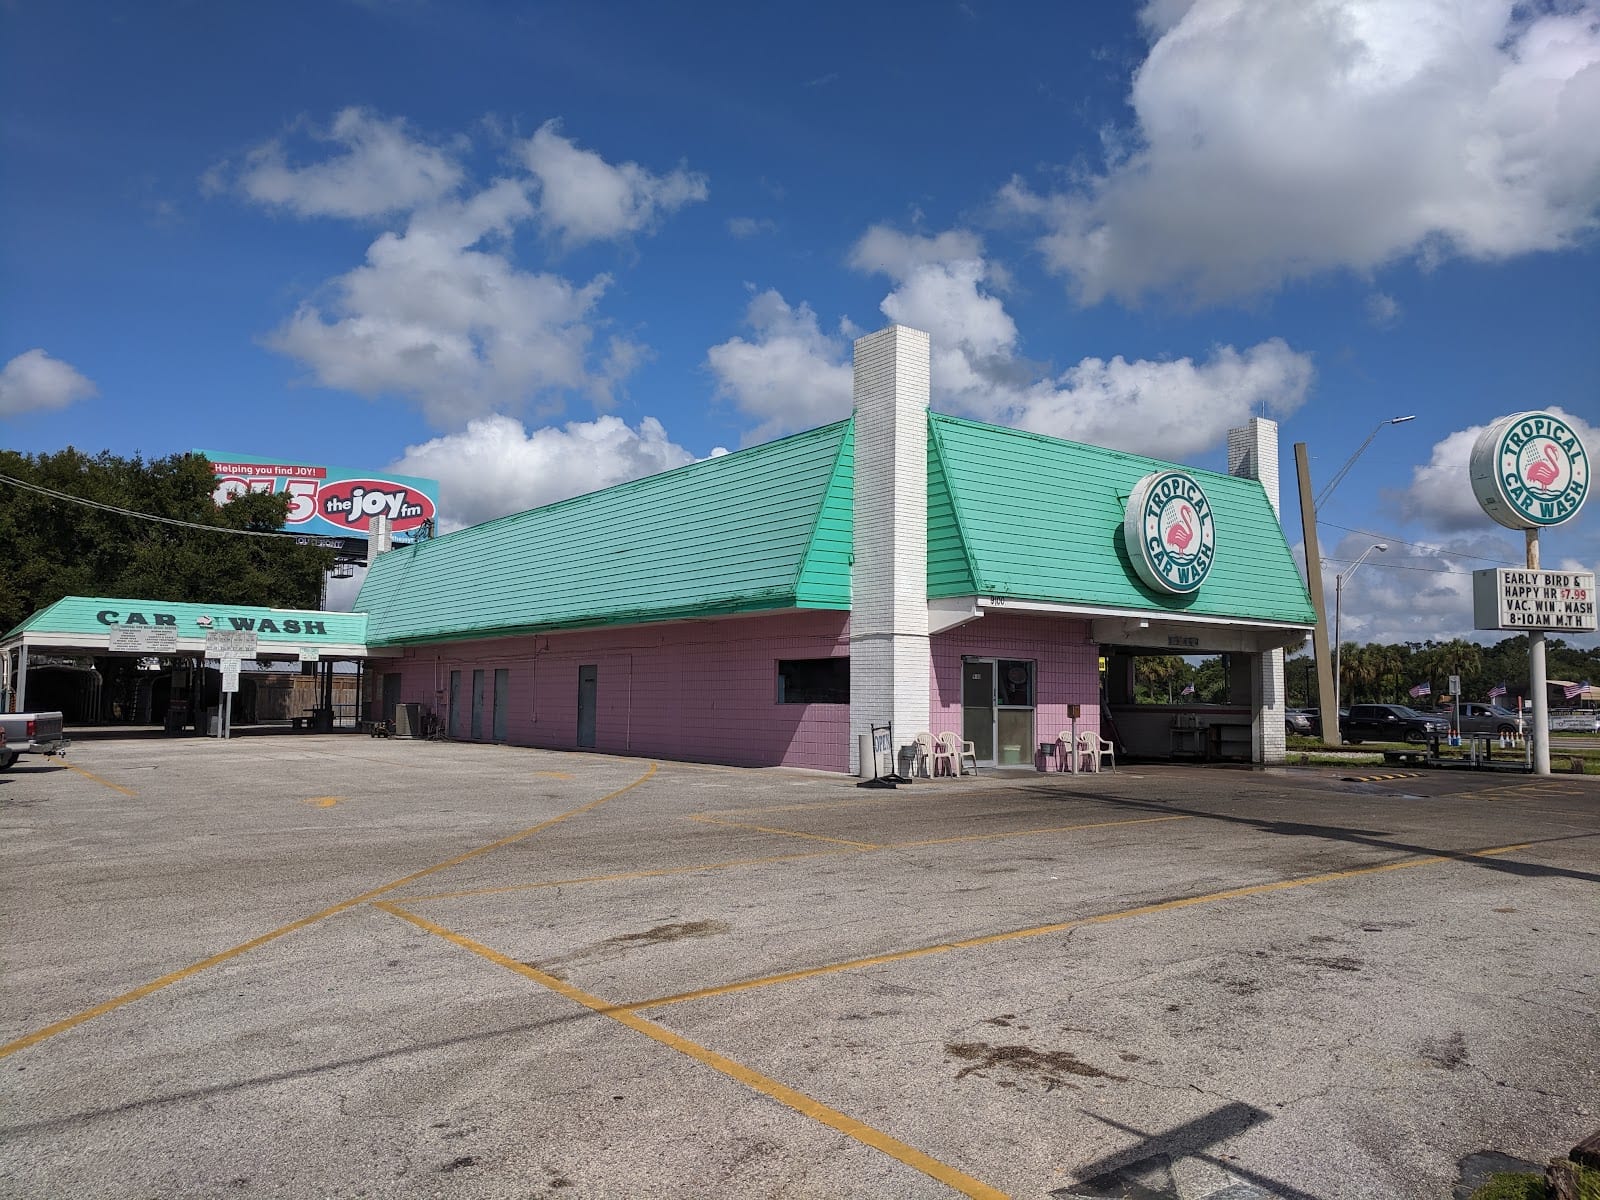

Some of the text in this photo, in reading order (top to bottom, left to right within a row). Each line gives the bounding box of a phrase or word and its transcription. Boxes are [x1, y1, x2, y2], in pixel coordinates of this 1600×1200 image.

[1505, 419, 1582, 464] TROPICAL
[215, 463, 316, 476] Helping you find JOY!
[1148, 479, 1209, 526] TROPICAL
[1505, 473, 1584, 518] CAR WASH
[1149, 536, 1211, 583] CAR WASH
[1505, 573, 1580, 586] EARLY BIRD &
[990, 596, 1005, 606] 9100
[1505, 586, 1587, 600] HAPPY HR $7.99
[1507, 600, 1531, 611] VAC.
[1565, 602, 1593, 613] WASH
[96, 610, 327, 635] CAR WASH
[1510, 613, 1551, 625] 8-10AM
[875, 734, 890, 752] OPEN
